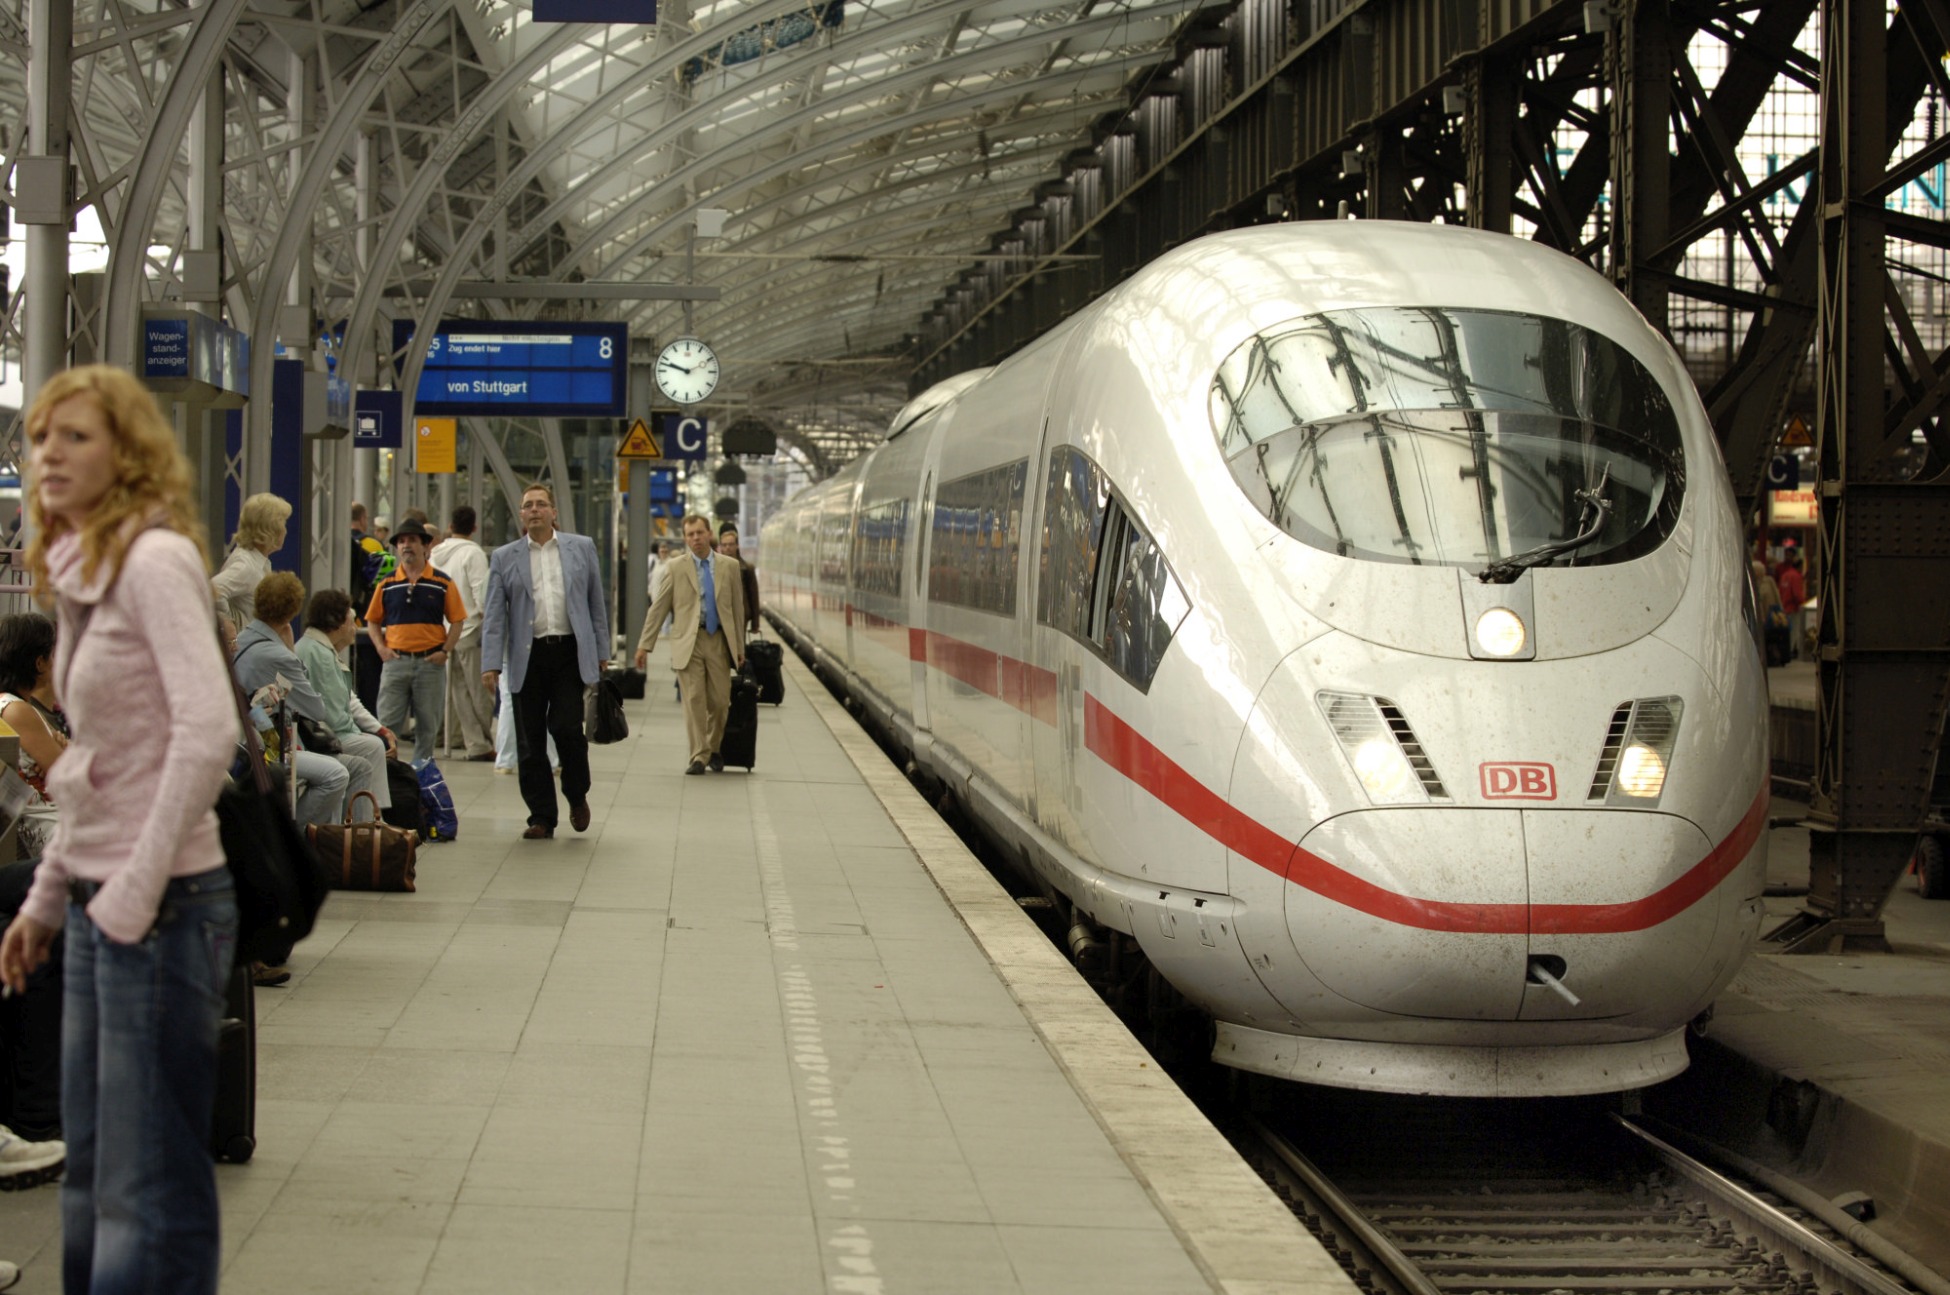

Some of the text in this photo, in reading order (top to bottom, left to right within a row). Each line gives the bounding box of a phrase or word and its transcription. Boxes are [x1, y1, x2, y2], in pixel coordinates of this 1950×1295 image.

[149, 332, 184, 342] Wagen-
[152, 344, 181, 353] stand-
[448, 344, 501, 354] Zug endet hier
[599, 337, 613, 359] 8
[147, 356, 186, 367] anzeiger
[447, 380, 527, 396] von Stuttgart
[676, 418, 701, 452] C
[1768, 455, 1787, 483] C
[1489, 767, 1548, 793] DB
